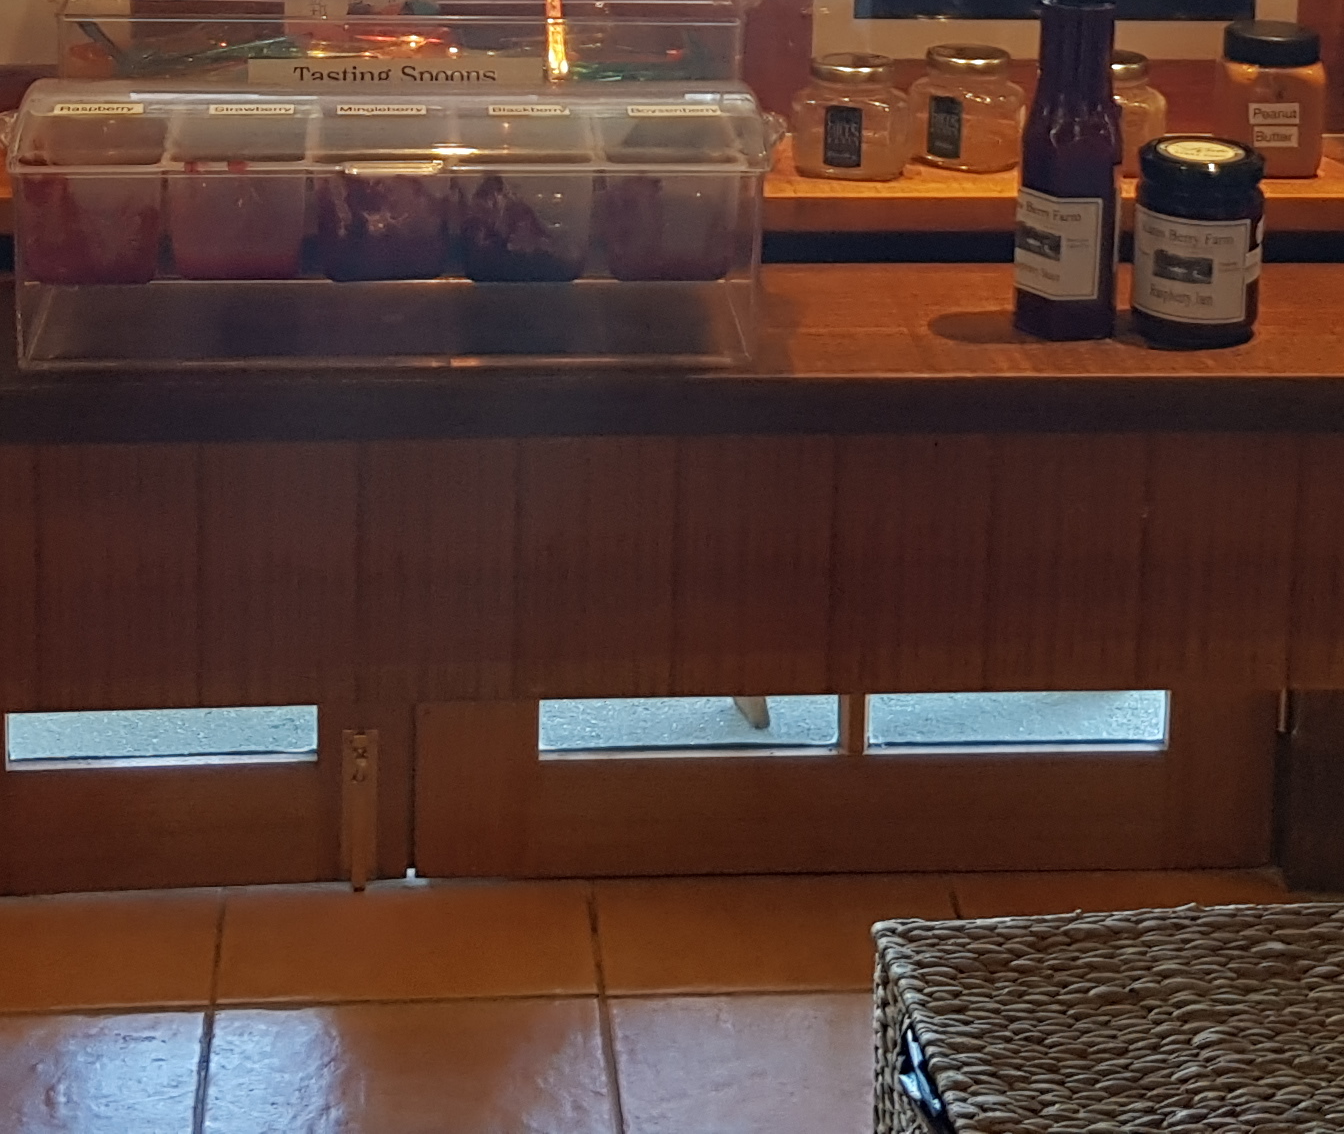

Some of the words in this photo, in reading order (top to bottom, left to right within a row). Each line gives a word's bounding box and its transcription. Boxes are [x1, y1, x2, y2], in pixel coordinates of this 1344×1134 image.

[293, 66, 392, 82] Tasting
[59, 105, 134, 113] Raspberry
[492, 106, 568, 114] Blackberry
[1253, 108, 1297, 119] Peanut
[1256, 131, 1293, 142] Butter
